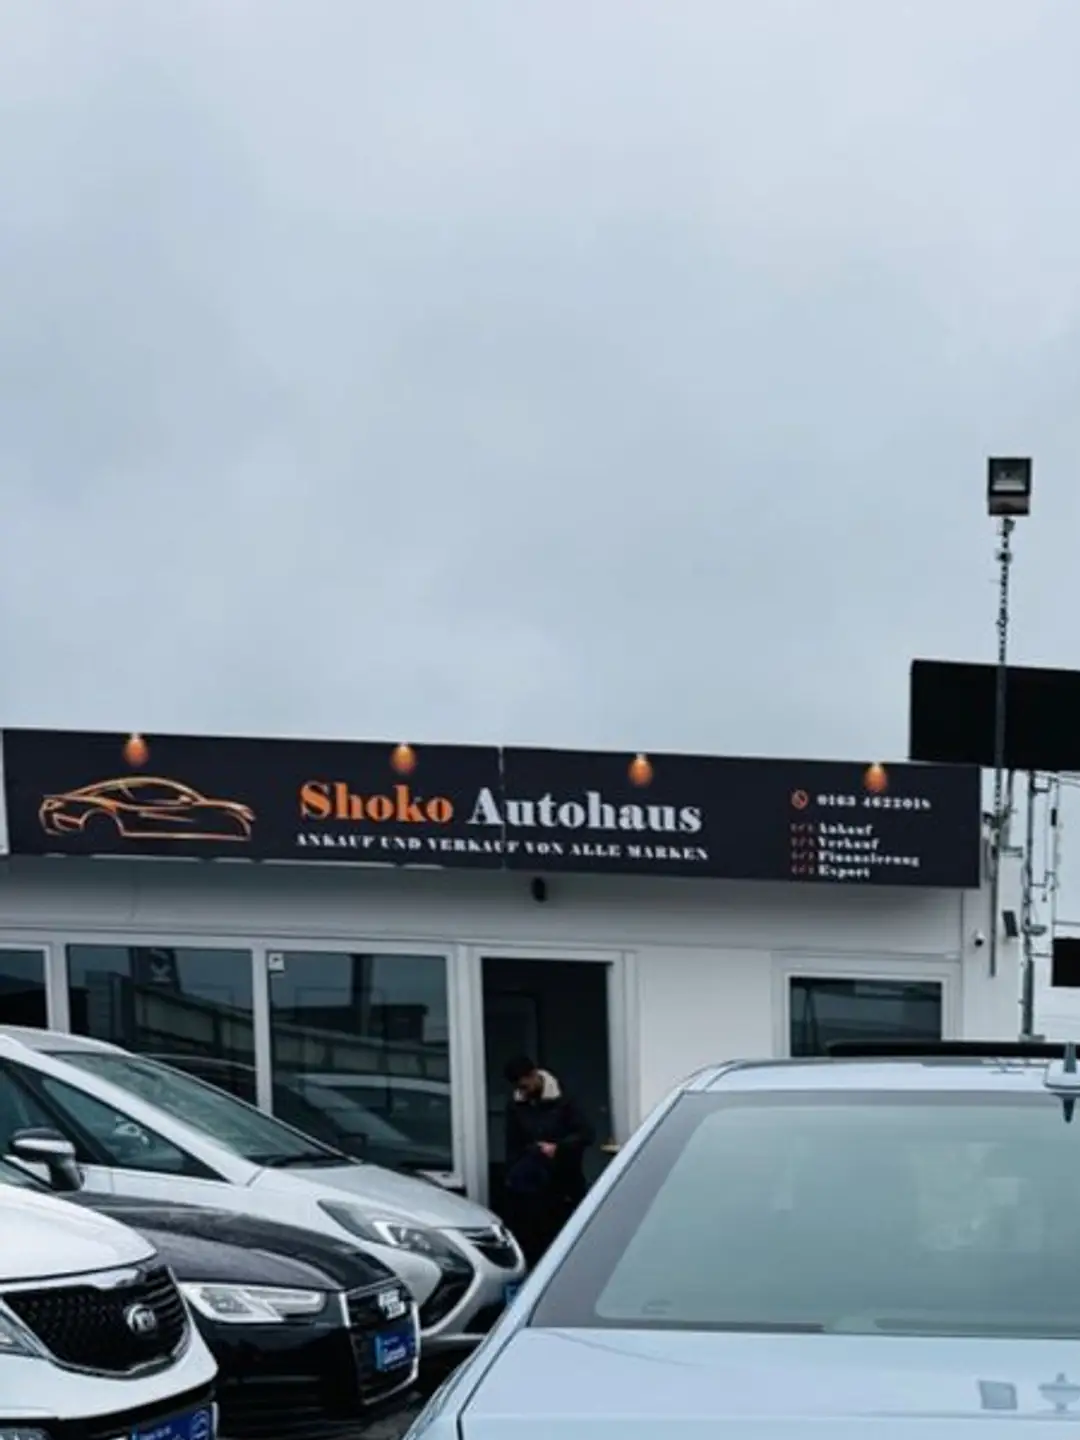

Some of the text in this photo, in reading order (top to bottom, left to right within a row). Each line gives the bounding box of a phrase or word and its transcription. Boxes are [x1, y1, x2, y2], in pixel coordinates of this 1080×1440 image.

[300, 780, 703, 833] Shoko Autohaus
[818, 822, 873, 836] Ankauf
[296, 833, 709, 861] ANKAUF UND VERKAUF VON ALLE MARKEN
[818, 836, 880, 850] Verkauf
[818, 864, 870, 879] Export
